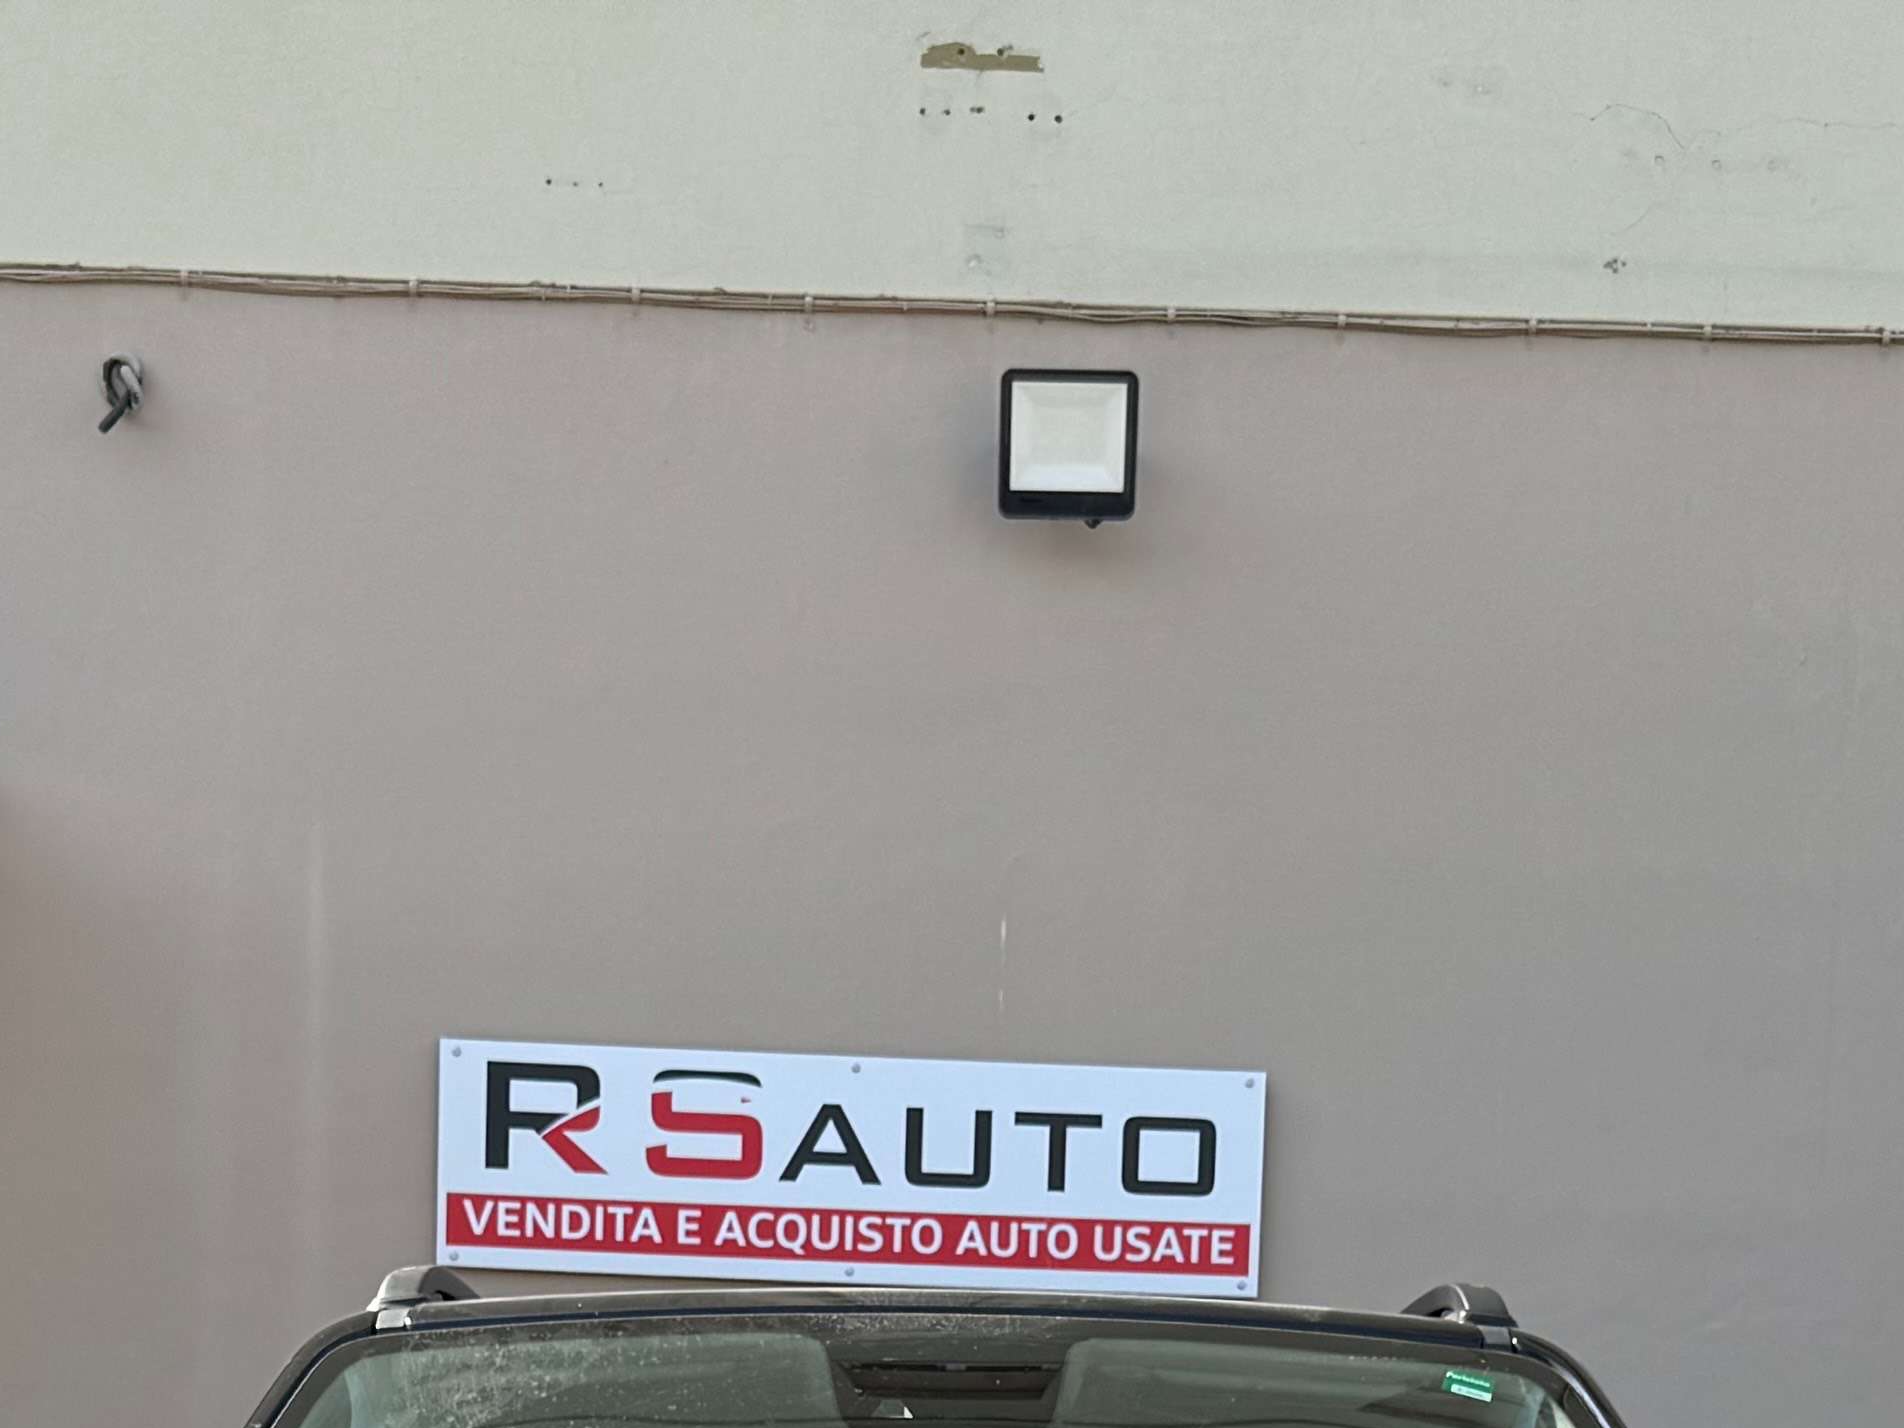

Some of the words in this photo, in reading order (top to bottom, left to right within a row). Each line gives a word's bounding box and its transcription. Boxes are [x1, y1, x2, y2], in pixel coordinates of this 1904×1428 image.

[463, 1199, 662, 1244] VENDITA
[677, 1209, 702, 1245] E
[714, 1210, 943, 1255] ACQUISTO
[955, 1220, 1078, 1260] AUTO
[1093, 1225, 1236, 1265] USATE
